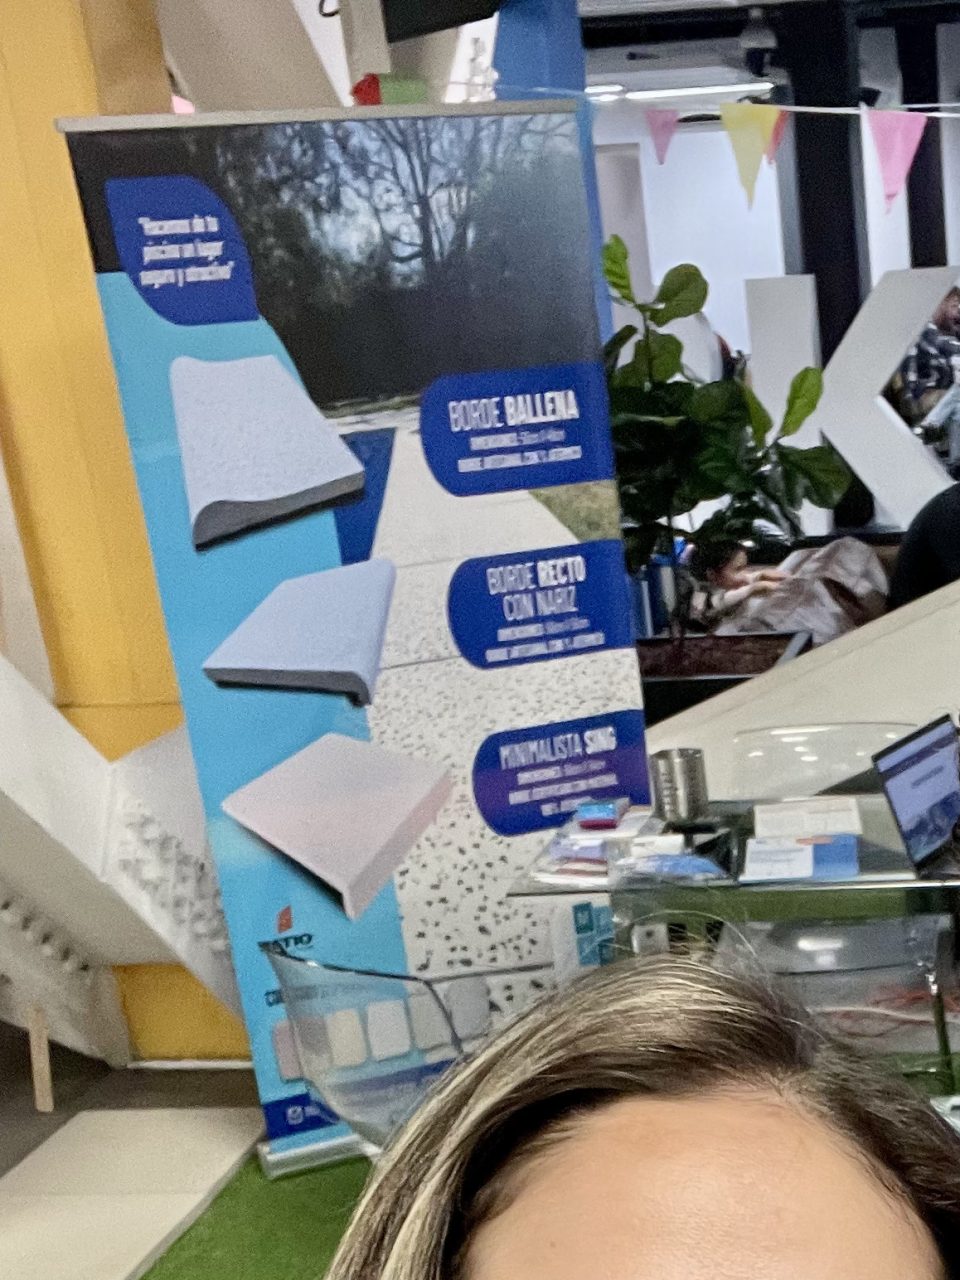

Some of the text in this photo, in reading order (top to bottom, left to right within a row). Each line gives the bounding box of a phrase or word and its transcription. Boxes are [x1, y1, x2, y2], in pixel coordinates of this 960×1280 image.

[448, 389, 580, 432] BORDE BALLENA
[486, 556, 586, 595] BORDE RECTO
[503, 593, 535, 620] CON
[499, 733, 583, 770] MINIMALISTA
